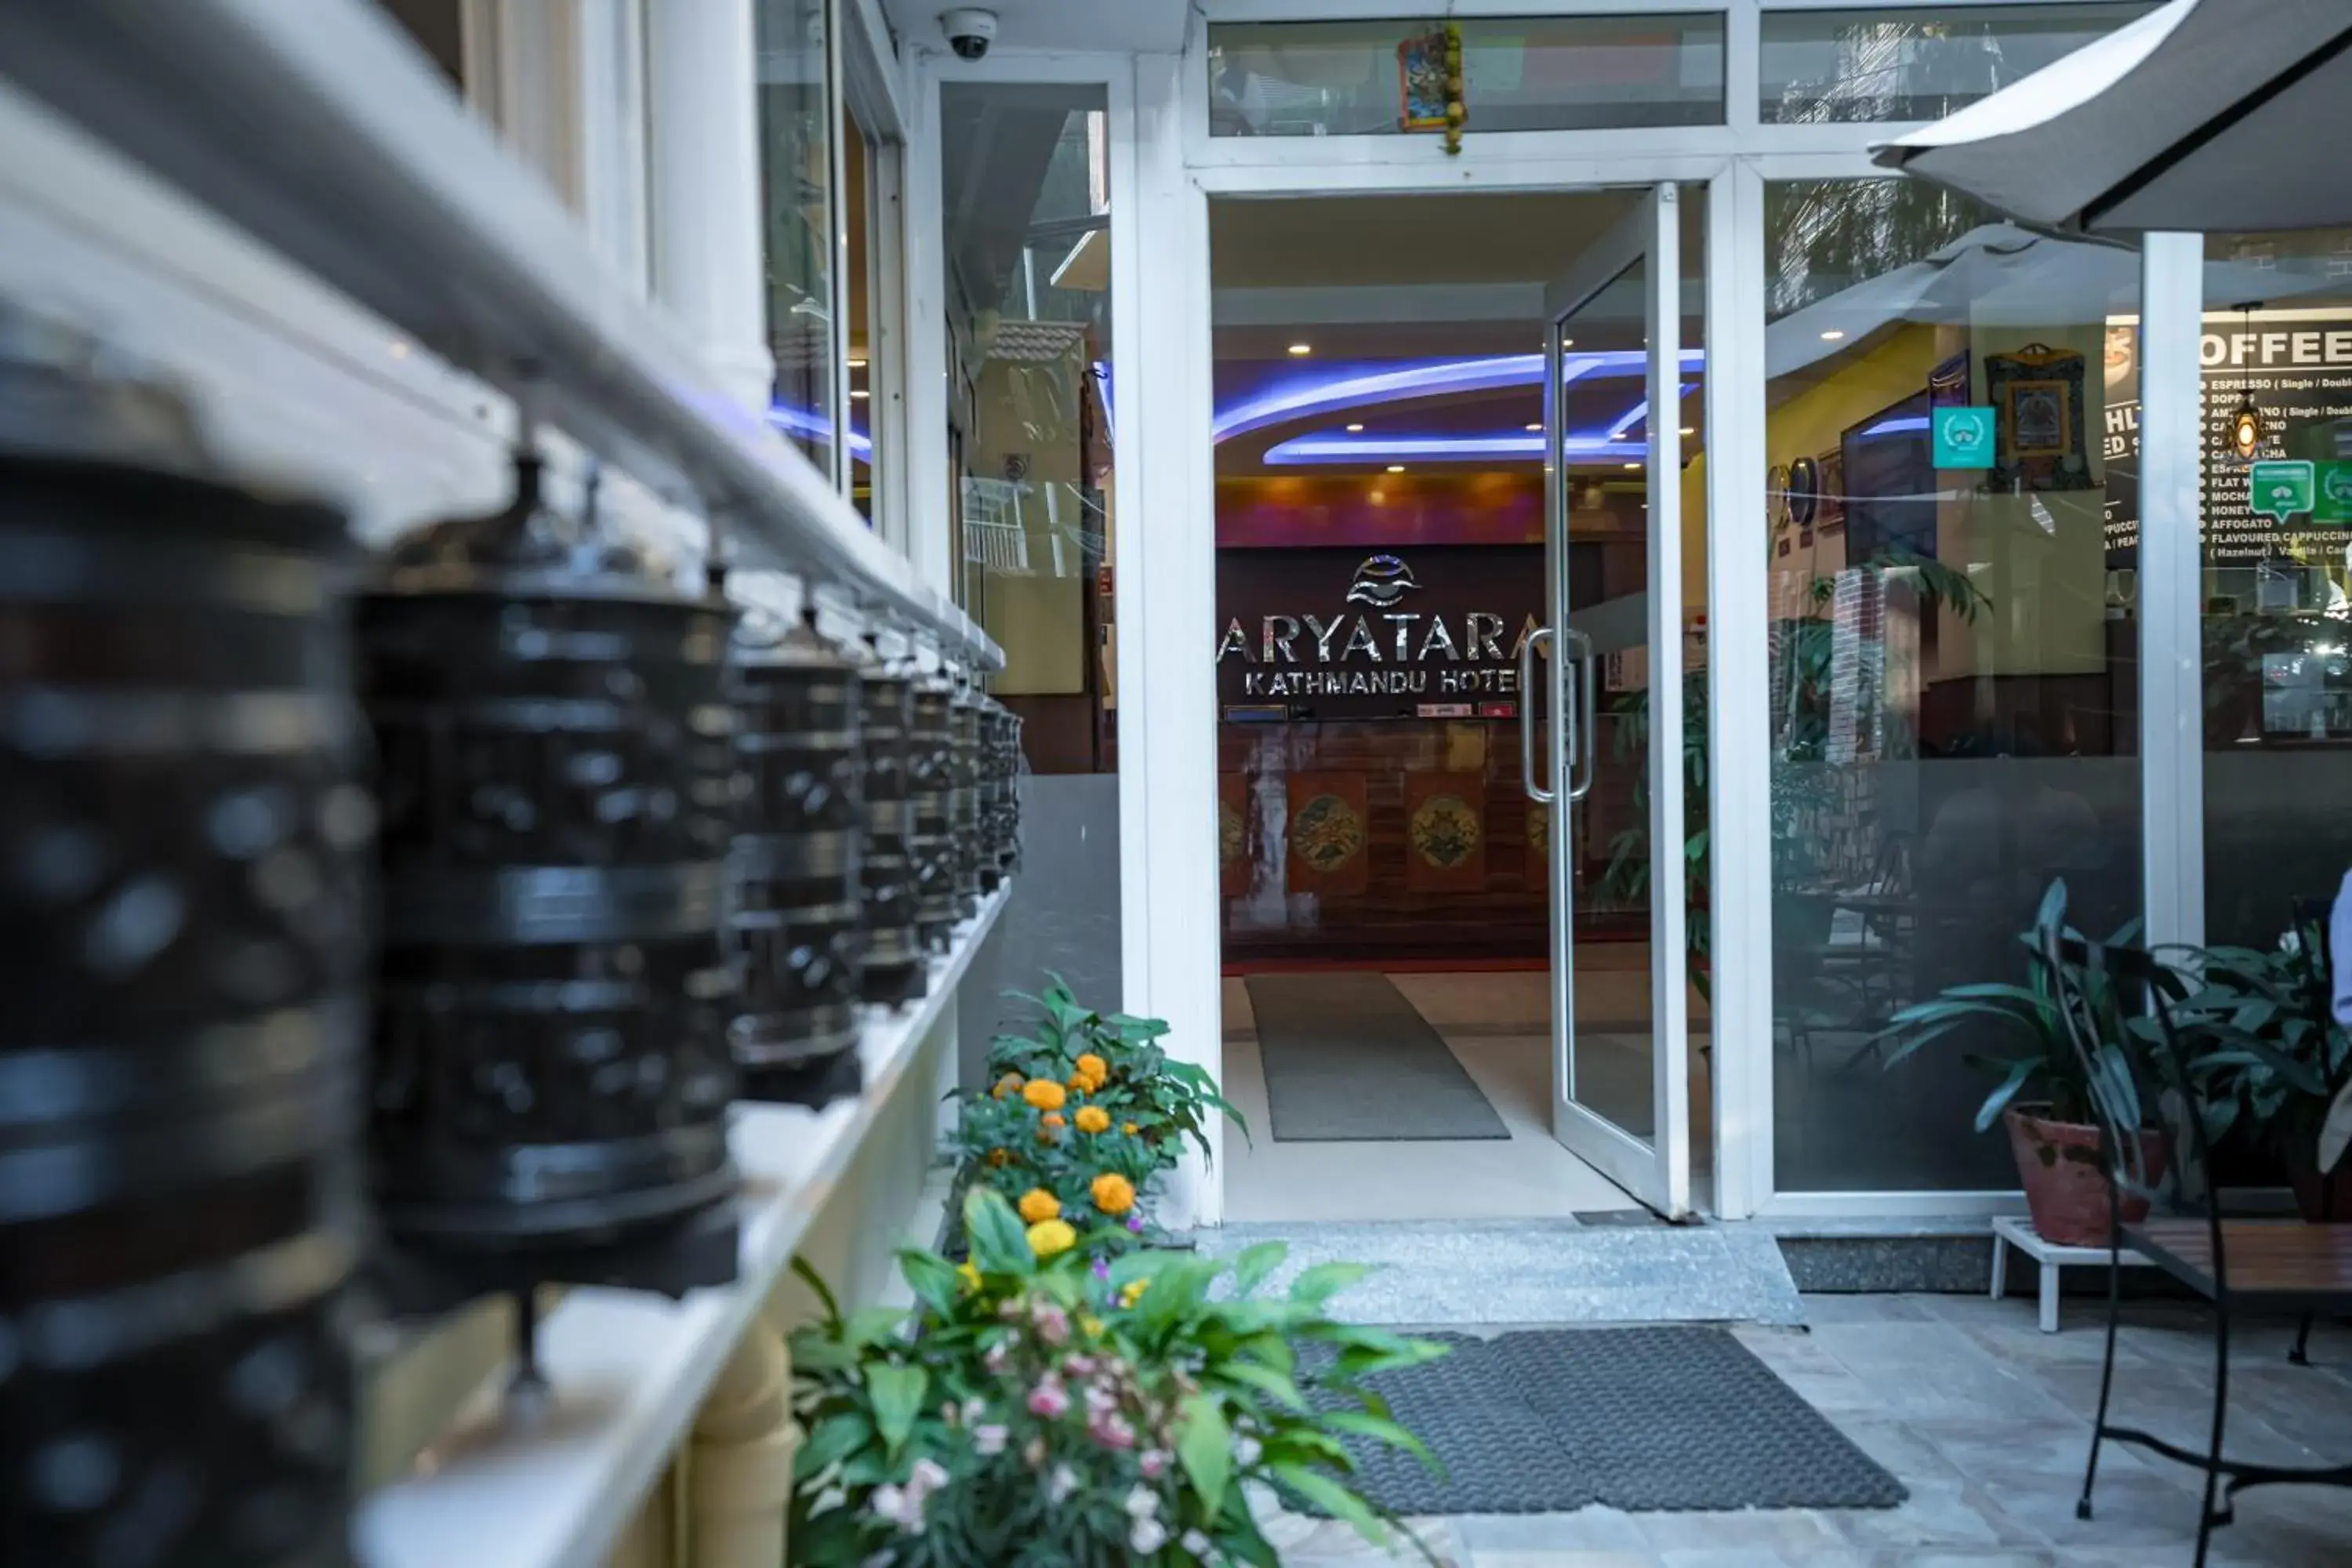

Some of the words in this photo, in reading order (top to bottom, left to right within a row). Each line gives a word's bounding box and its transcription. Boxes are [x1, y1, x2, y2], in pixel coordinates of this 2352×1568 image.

[2211, 379, 2271, 390] ESPRESSO
[2281, 379, 2314, 390] Single
[2321, 378, 2352, 387] Doubl
[2211, 478, 2240, 488] FLAT
[2211, 506, 2251, 515] HONEY
[2211, 519, 2272, 529] AFFOGATO
[2212, 533, 2280, 544] FLAVOURED
[1217, 613, 1549, 663] ARYATARA
[1245, 671, 1427, 696] KATHMANDU
